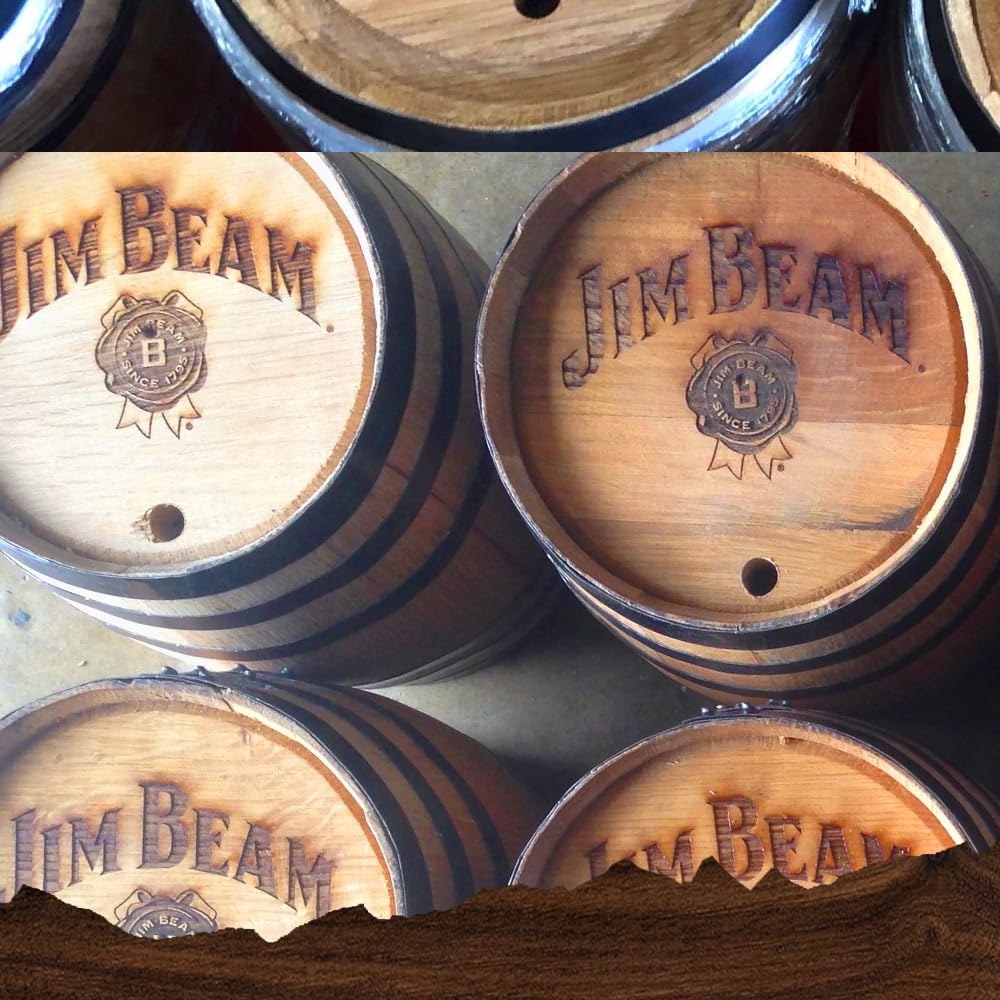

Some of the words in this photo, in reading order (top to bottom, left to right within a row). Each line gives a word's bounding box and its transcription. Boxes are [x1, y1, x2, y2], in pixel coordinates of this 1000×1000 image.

[116, 184, 321, 328] BEAM
[562, 251, 694, 390] JIM
[703, 224, 912, 365] BEAM
[123, 323, 143, 348] JIM
[141, 338, 168, 367] B
[122, 359, 161, 389] SINCE
[164, 356, 188, 385] 1795
[713, 365, 733, 389] JIM
[736, 359, 777, 385] BEAM
[713, 400, 752, 430] SINCE
[137, 780, 338, 919] BEAM
[159, 915, 195, 936] BEA
